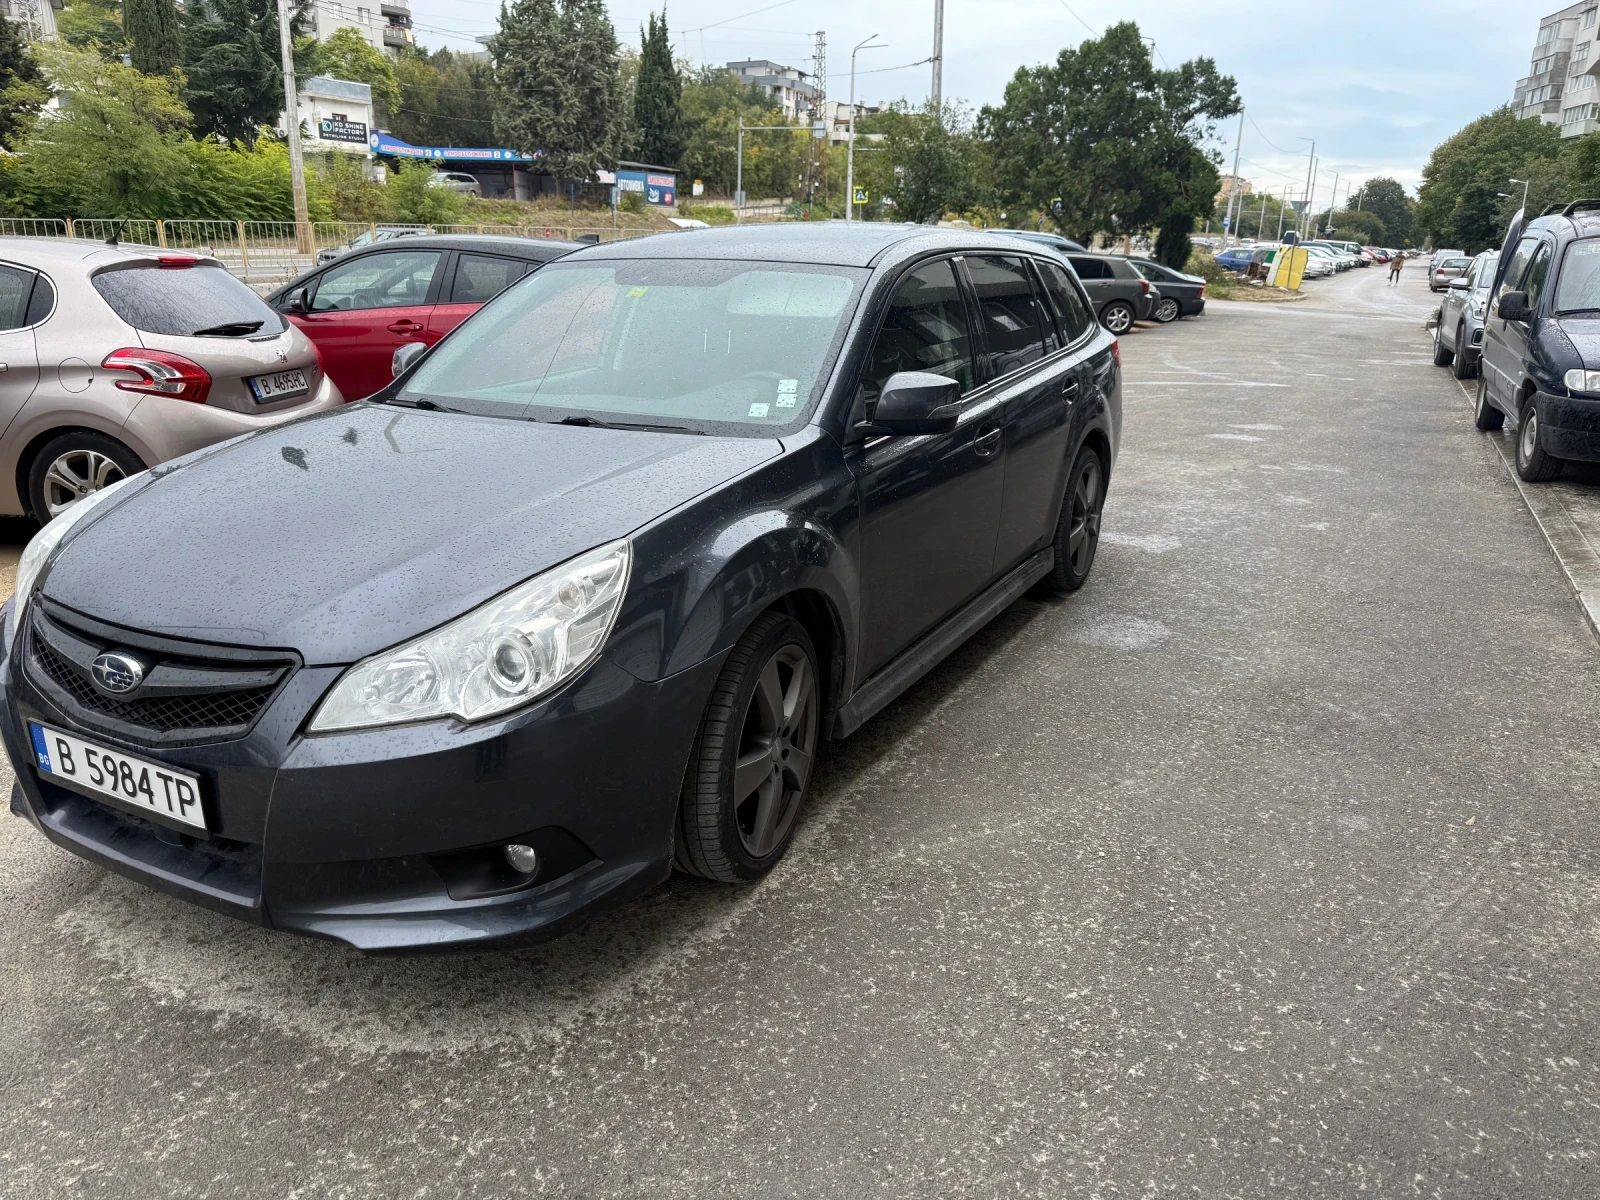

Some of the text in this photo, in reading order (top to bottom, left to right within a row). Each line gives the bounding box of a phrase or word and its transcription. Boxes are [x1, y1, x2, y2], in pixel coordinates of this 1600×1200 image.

[261, 378, 271, 394] B
[38, 753, 50, 765] BG
[56, 737, 195, 816] B 5984 TP
